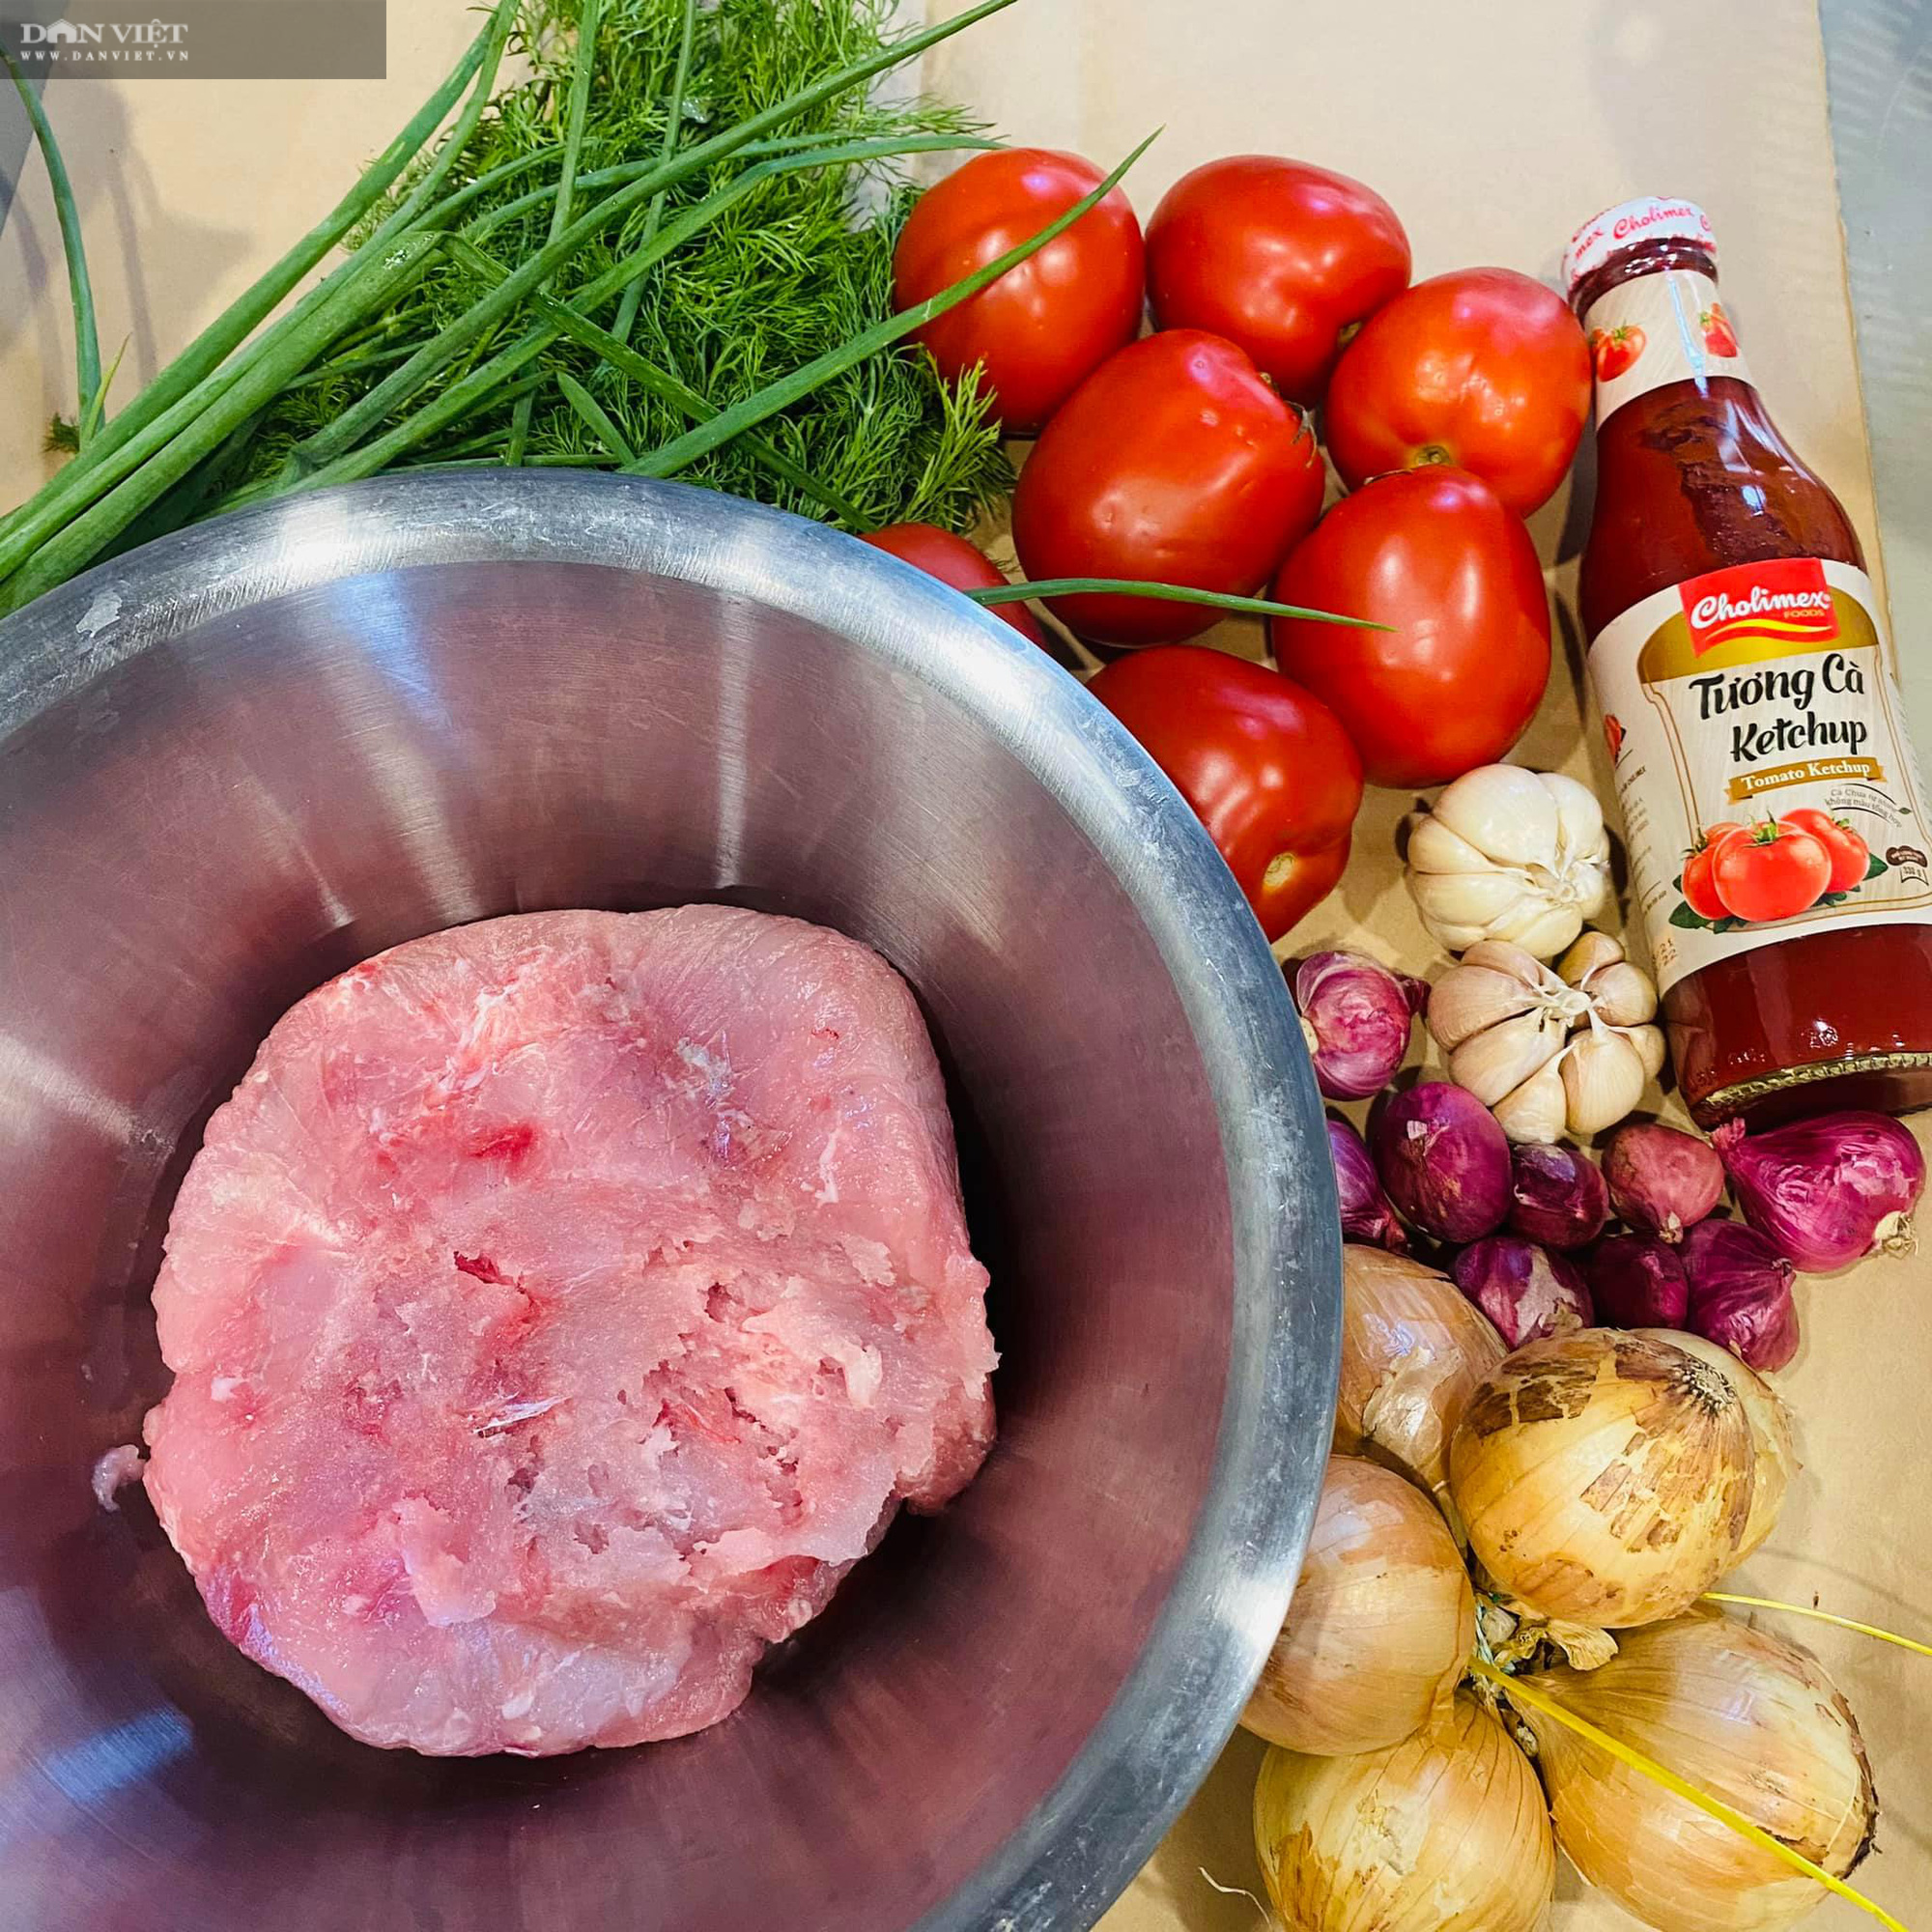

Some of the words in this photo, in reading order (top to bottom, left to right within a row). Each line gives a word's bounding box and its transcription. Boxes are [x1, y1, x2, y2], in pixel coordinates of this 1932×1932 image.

[1613, 206, 1695, 241] Cholimex
[1690, 585, 1830, 629] Cholimex
[1783, 609, 1825, 619] FOODS
[1689, 668, 1814, 721] Tương
[1822, 653, 1865, 695] Cà
[1729, 710, 1867, 762] Ketchup
[1740, 767, 1805, 791] Tomato
[1805, 759, 1871, 778] Ketchup
